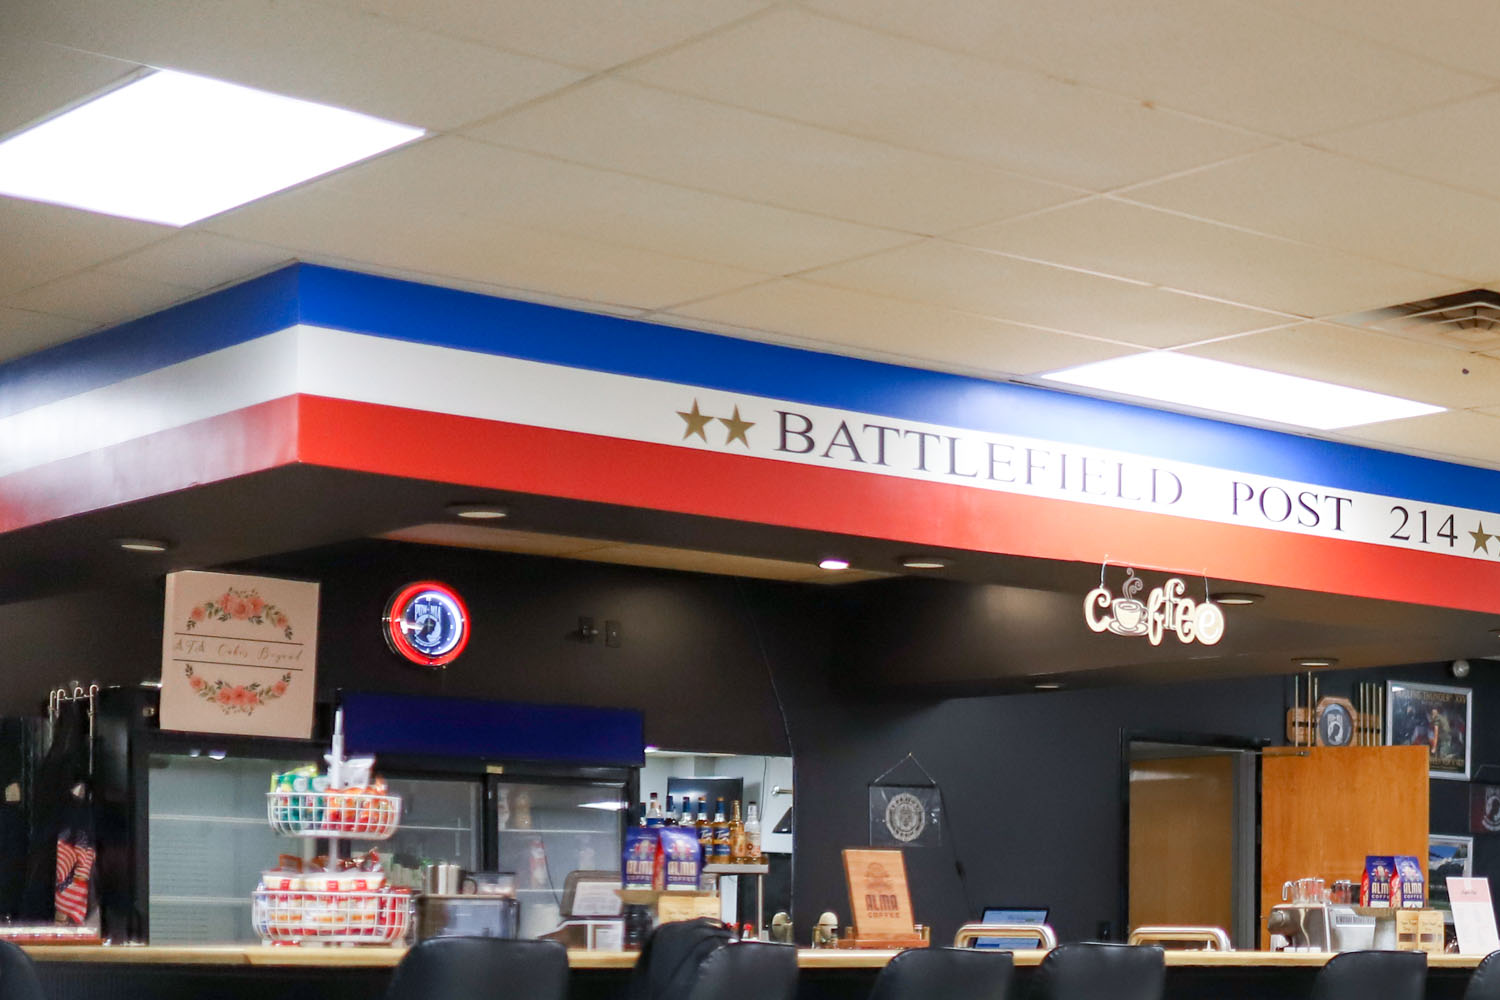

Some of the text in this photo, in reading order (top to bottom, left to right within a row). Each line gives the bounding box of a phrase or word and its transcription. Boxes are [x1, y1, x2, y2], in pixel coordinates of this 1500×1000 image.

[773, 410, 1459, 548] BATTLEFIELD POST 214
[1403, 882, 1423, 894] ALMA
[864, 894, 899, 911] ALMA
